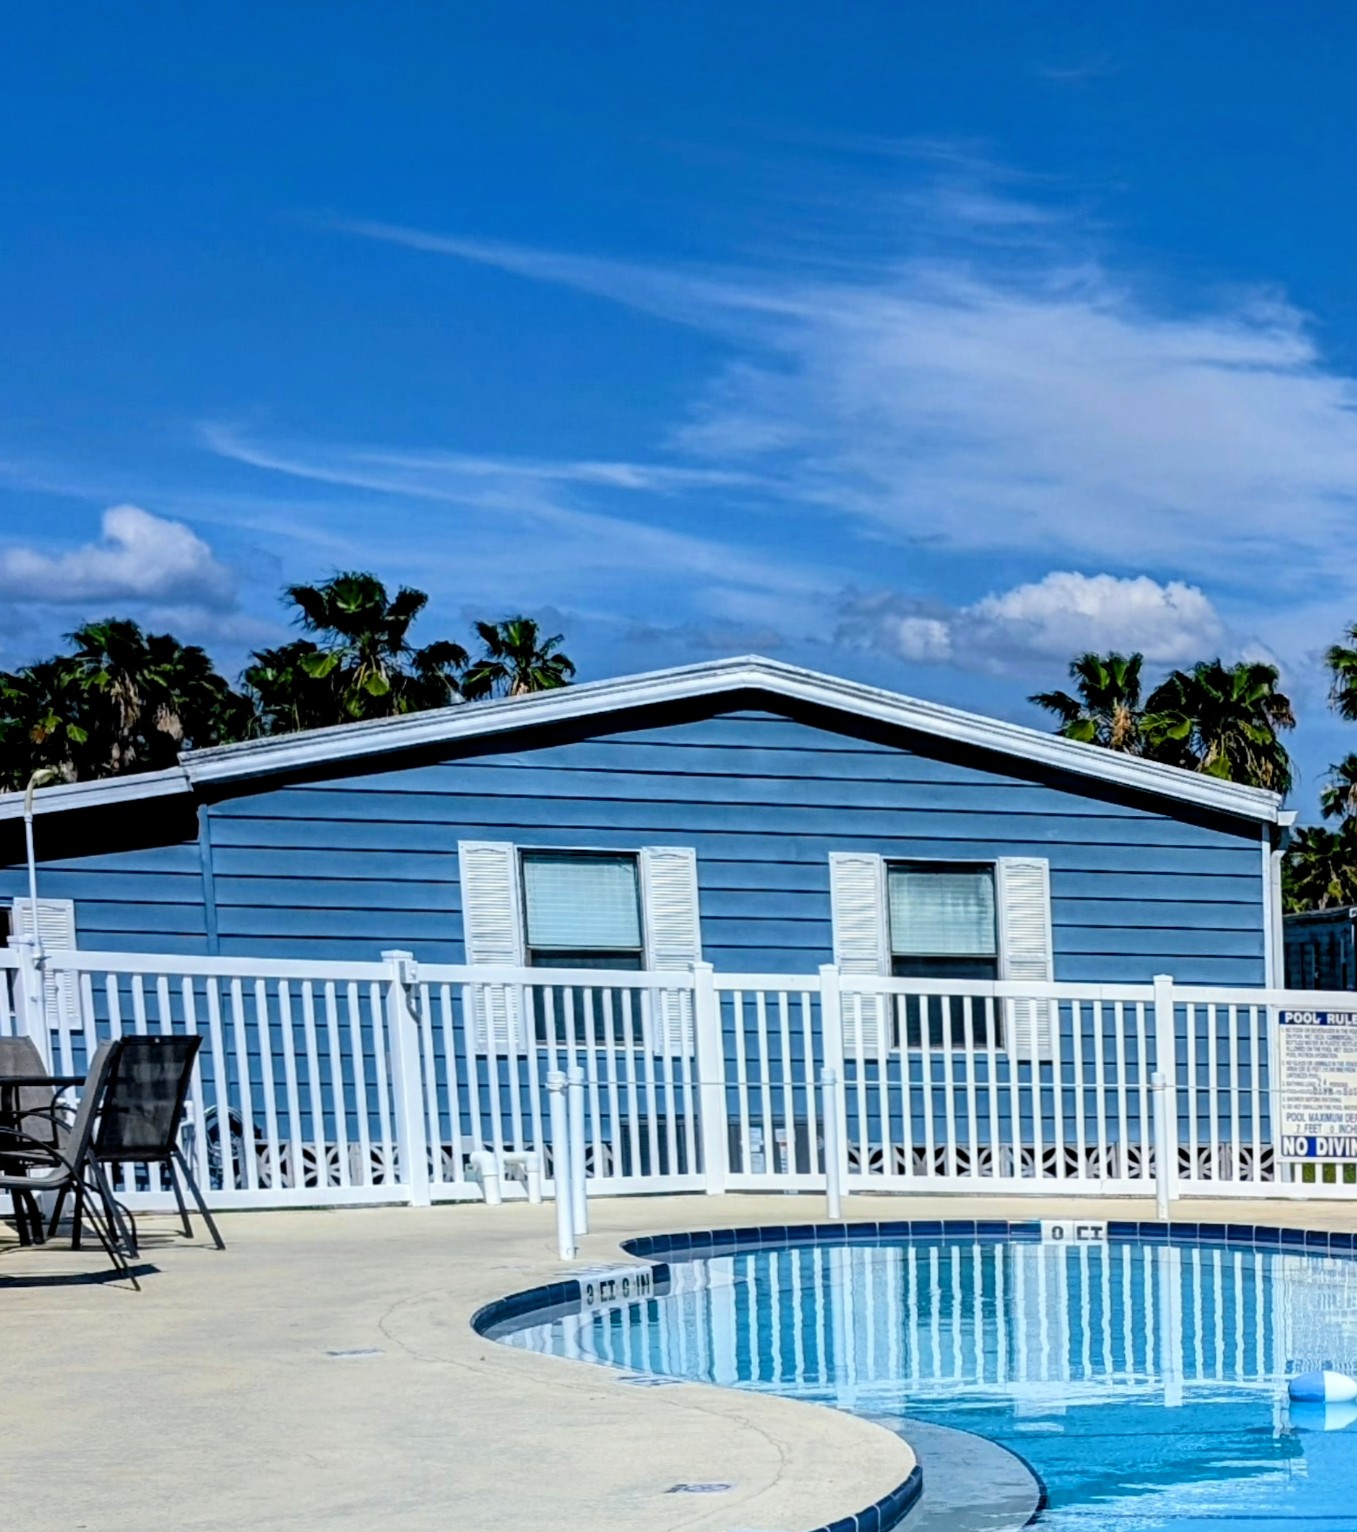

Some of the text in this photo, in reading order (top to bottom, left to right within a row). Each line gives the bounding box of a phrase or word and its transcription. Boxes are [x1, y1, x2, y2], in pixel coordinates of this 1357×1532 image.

[1285, 1012, 1321, 1024] POOL
[1286, 1113, 1305, 1122] POOL
[1309, 1113, 1343, 1123] MAXIMUM
[1304, 1125, 1322, 1134] FEET
[1283, 1138, 1308, 1155] NO
